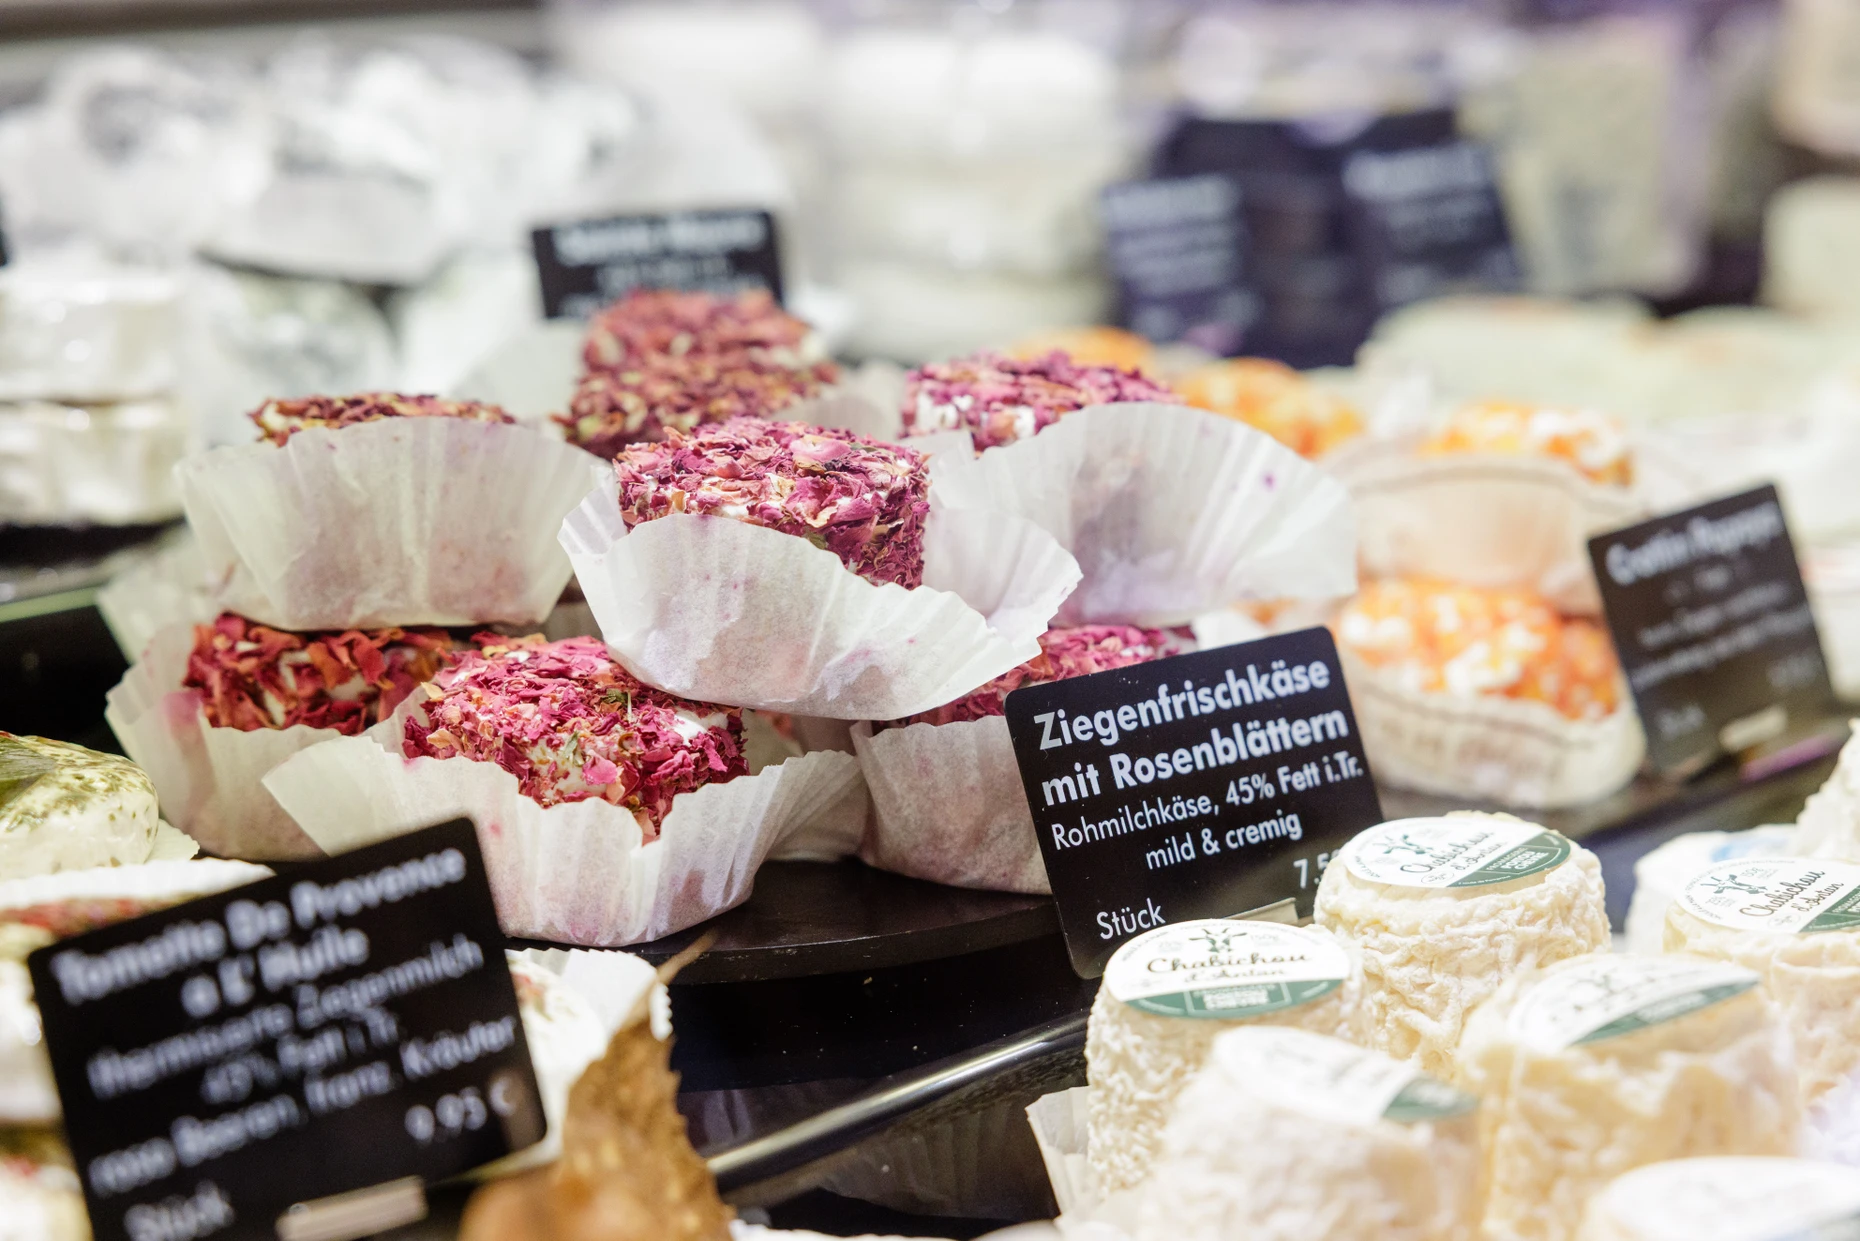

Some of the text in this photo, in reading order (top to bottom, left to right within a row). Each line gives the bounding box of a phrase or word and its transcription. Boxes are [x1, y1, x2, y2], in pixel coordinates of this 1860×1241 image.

[1034, 661, 1330, 750] Ziegenfrischkäse
[1042, 710, 1348, 806] mit Rosenblättern
[1051, 791, 1220, 850] Rohmilchkäse,
[1226, 773, 1276, 807] 45%
[1278, 761, 1320, 795] Fett
[1146, 810, 1303, 870] mild & cremig
[290, 849, 466, 927] Provence
[1096, 898, 1166, 940] Stück
[1739, 870, 1825, 917] Chabichou
[294, 934, 484, 1029] Ziegenmilch
[1148, 952, 1311, 974] Chabichou
[277, 1027, 346, 1076] Fett
[401, 1015, 516, 1079] Kräuter
[124, 1182, 235, 1241] Stück
